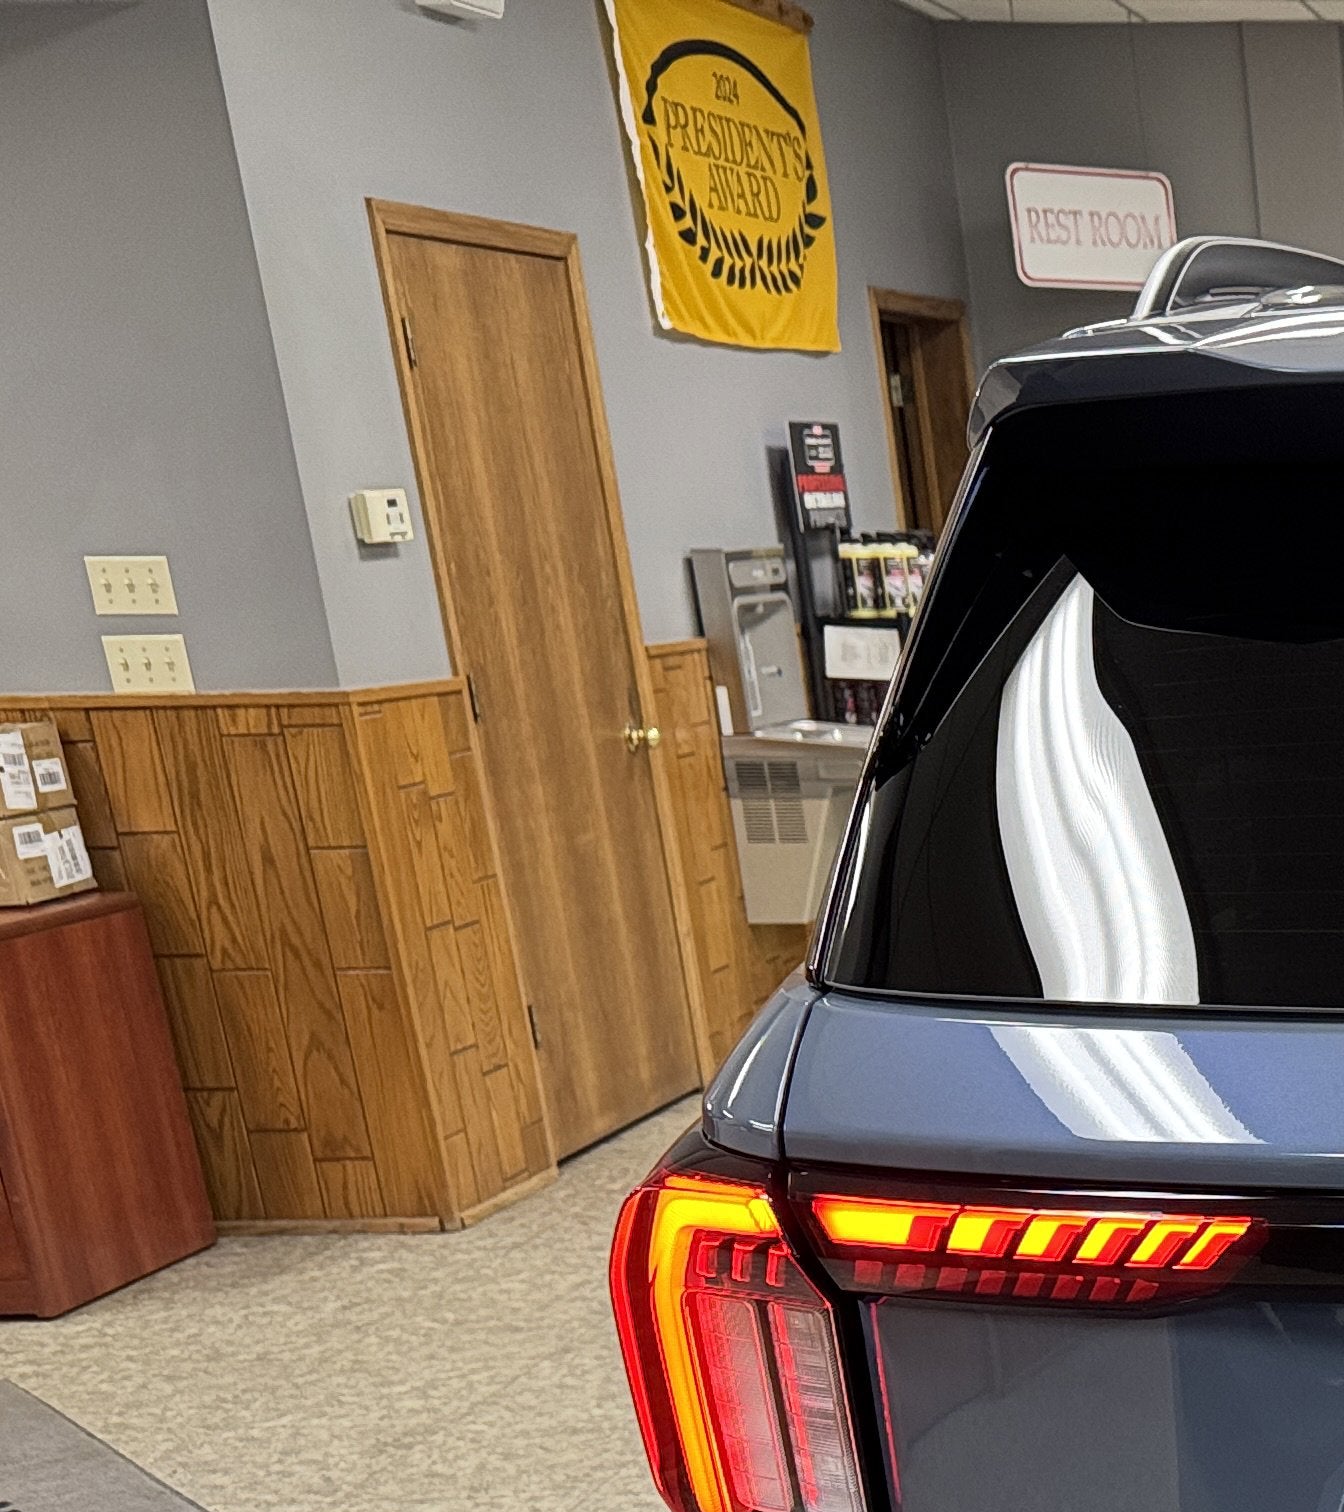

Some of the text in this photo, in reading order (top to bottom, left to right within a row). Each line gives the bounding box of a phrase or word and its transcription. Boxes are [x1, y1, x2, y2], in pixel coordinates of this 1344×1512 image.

[661, 96, 804, 183] PRESIDENT'S
[708, 162, 782, 224] AWARD
[1025, 206, 1163, 250] REST ROOM
